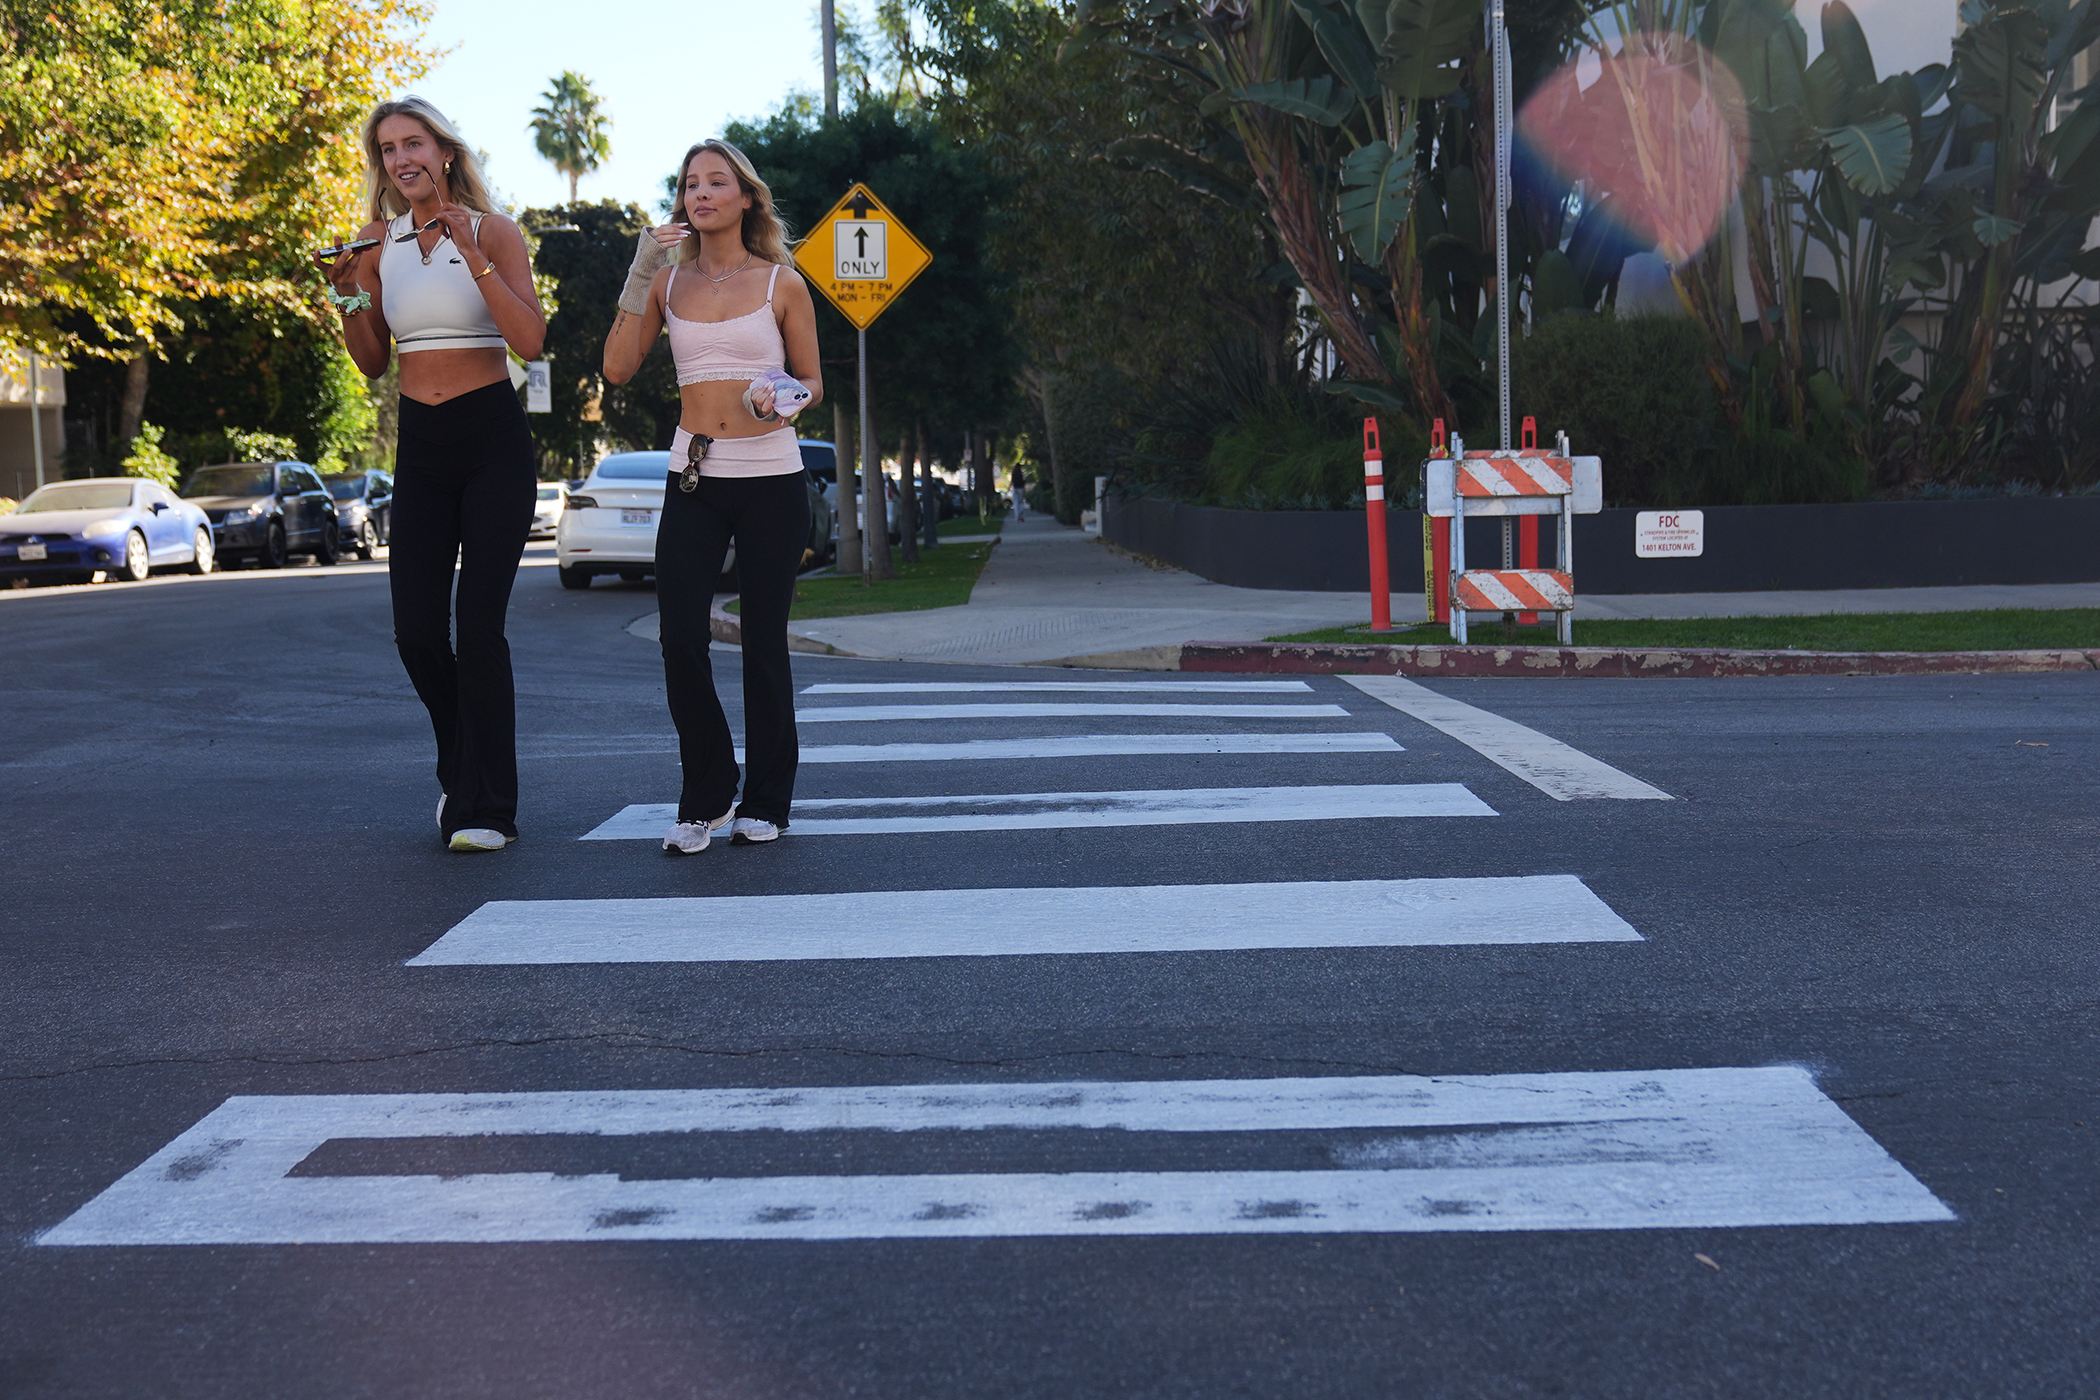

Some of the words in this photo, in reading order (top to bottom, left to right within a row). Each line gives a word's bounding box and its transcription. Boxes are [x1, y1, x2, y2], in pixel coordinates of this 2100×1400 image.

[841, 261, 880, 275] ONLY
[830, 282, 836, 290] 4
[841, 282, 855, 292] PM
[868, 282, 874, 292] 7
[878, 282, 892, 292] PM
[837, 293, 858, 302] MON
[871, 293, 886, 302] FRI
[1659, 515, 1680, 528] FDC
[1642, 544, 1657, 552] 1401
[1658, 543, 1682, 551] KELTON
[1683, 542, 1697, 551] AVE.
